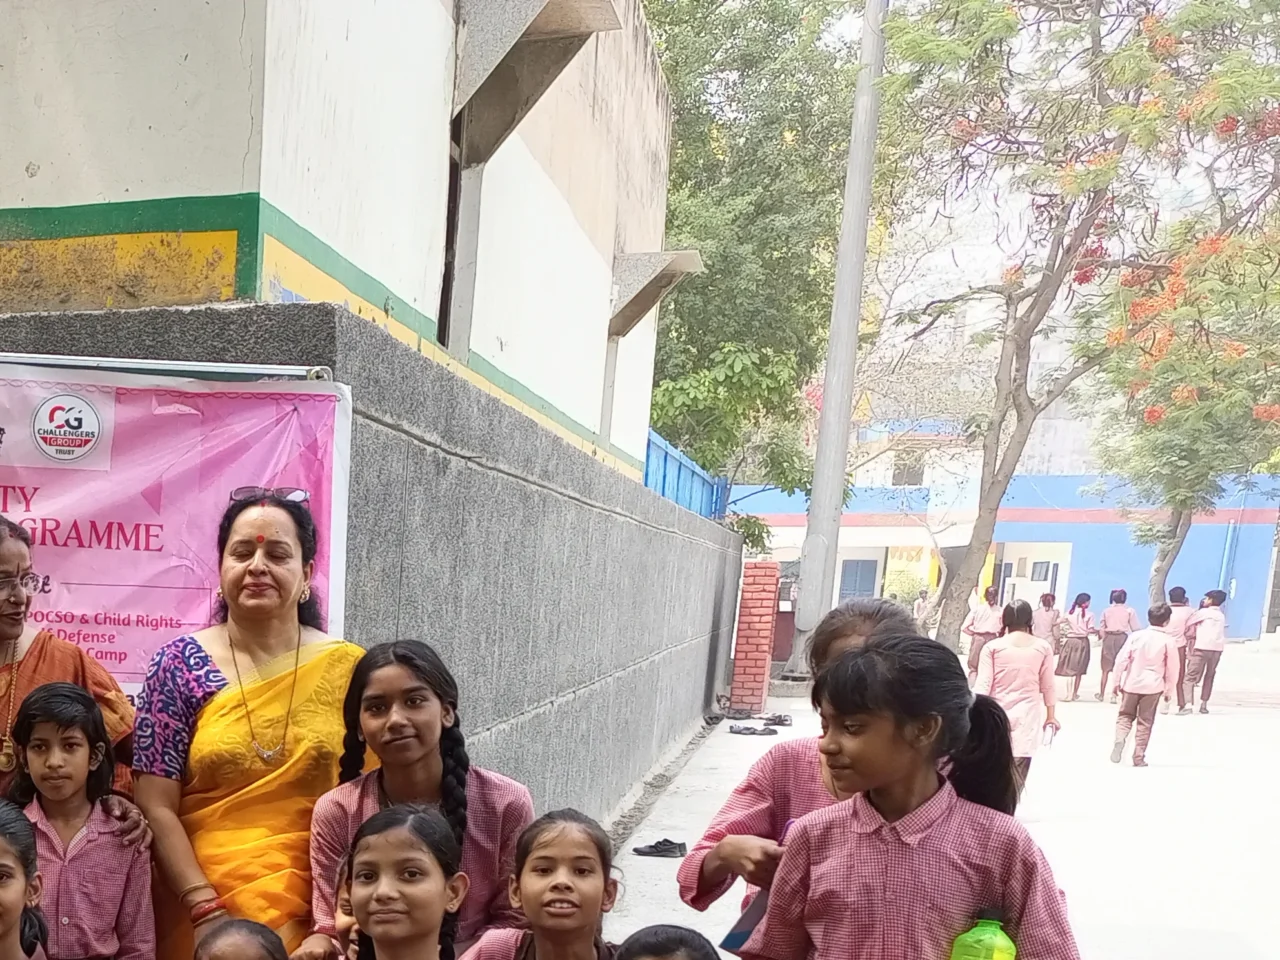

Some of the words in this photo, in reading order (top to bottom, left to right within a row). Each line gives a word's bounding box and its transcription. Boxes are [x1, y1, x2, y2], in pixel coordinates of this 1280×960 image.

[37, 428, 96, 438] CHALLENGERS
[51, 438, 82, 447] GROUP
[55, 448, 76, 456] TRUST
[19, 517, 164, 552] GRAMME
[80, 613, 90, 625] &
[94, 613, 131, 627] Child
[135, 615, 183, 631] Rights
[57, 628, 116, 646] Defense
[86, 648, 128, 664] Camp
